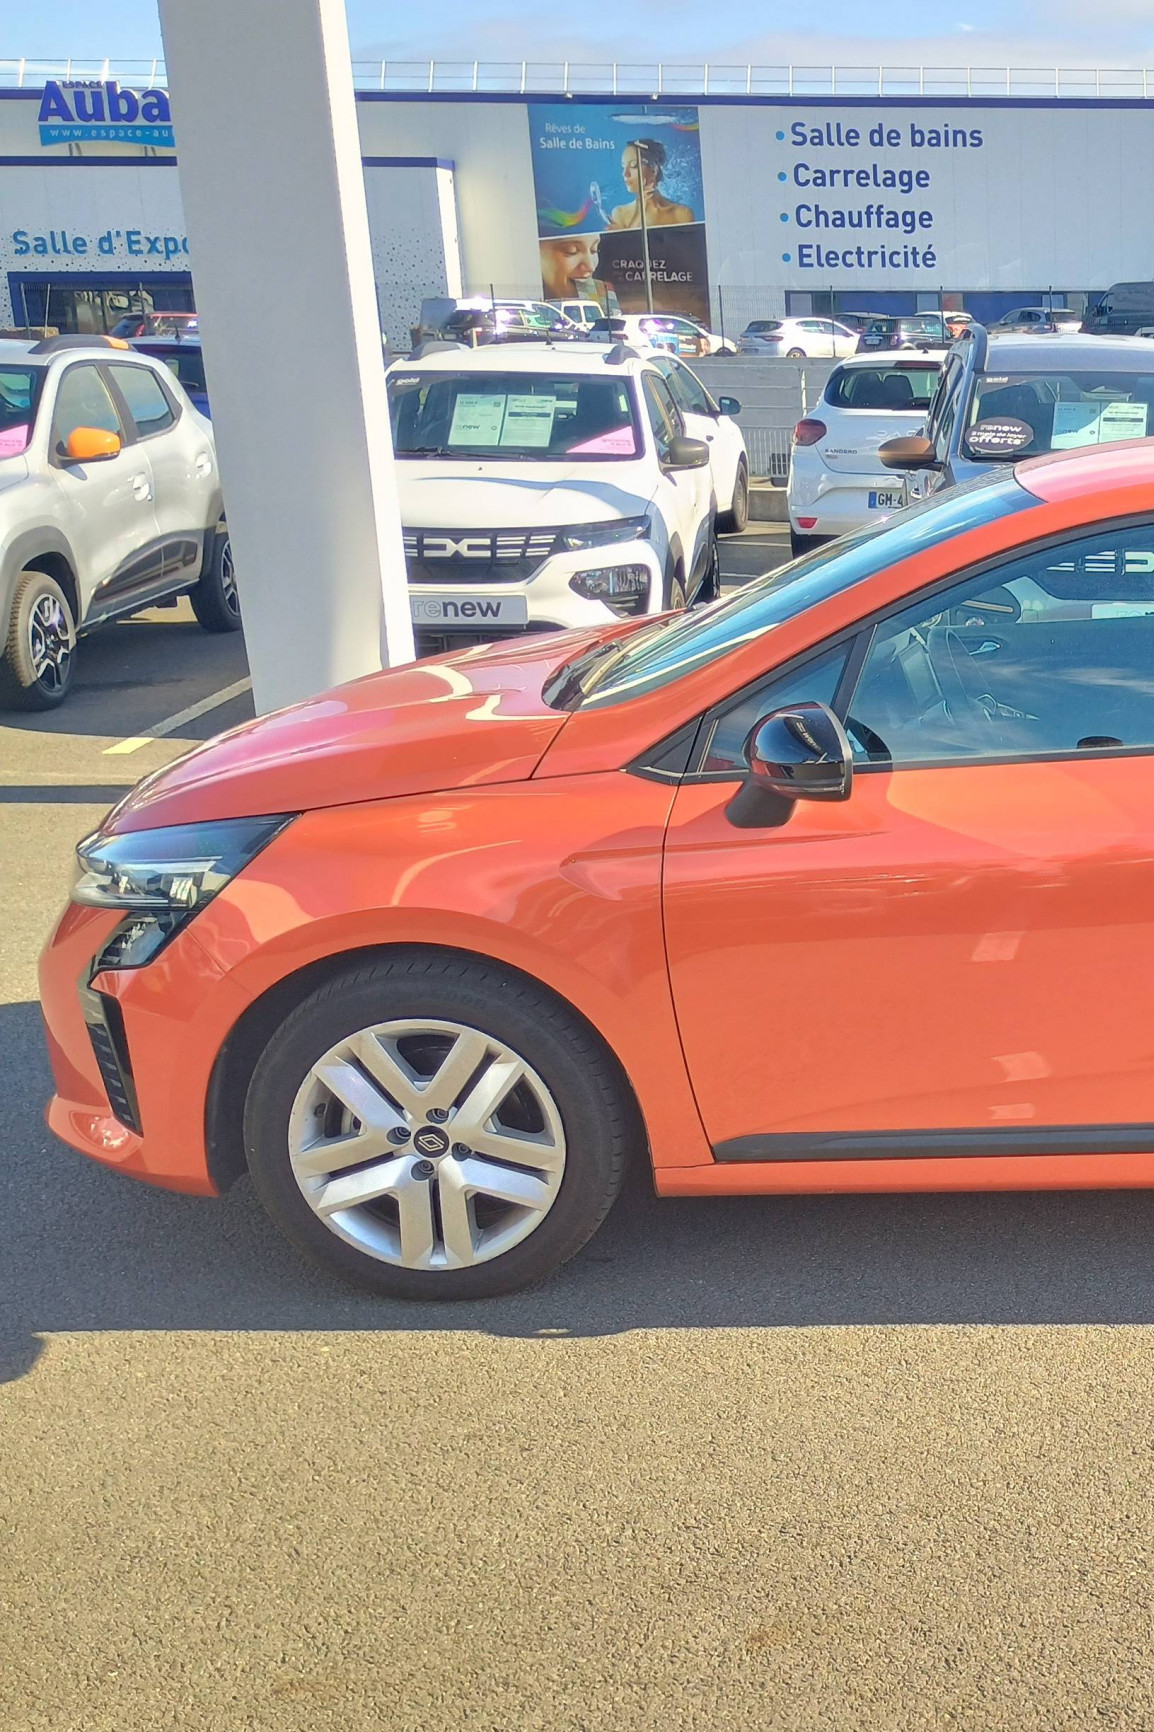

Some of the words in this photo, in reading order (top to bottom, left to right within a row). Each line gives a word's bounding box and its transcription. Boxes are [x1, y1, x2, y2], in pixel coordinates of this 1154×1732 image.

[545, 123, 572, 134] Rêves
[573, 123, 586, 134] de
[791, 121, 860, 147] Salle
[869, 122, 901, 148] de
[910, 123, 984, 148] bains
[539, 137, 567, 149] Salle
[569, 138, 583, 149] de
[585, 138, 615, 150] Bains
[793, 163, 930, 194] Carrelage
[795, 204, 933, 234] Chauffage
[13, 230, 88, 255] Salle
[612, 259, 667, 269] CRAQEZ
[798, 244, 937, 268] Electricité
[413, 600, 501, 618] renew
